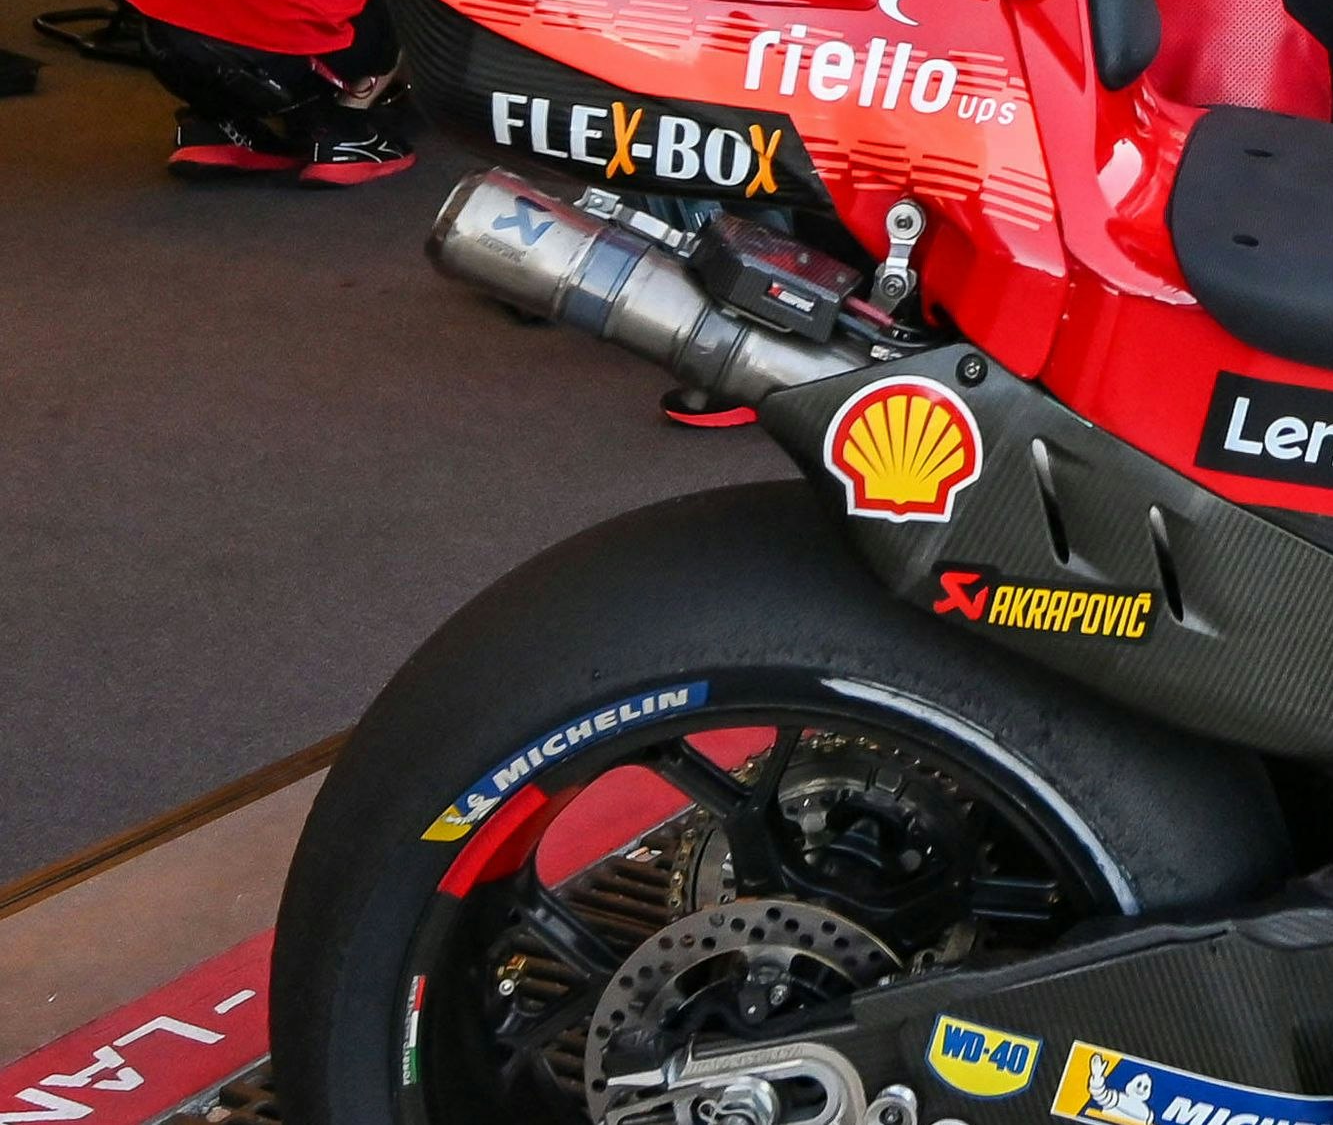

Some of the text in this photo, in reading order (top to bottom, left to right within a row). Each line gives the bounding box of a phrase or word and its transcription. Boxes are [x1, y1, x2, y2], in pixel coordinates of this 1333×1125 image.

[744, 23, 1018, 127] riello ups
[491, 91, 783, 198] FLEX-BOX
[988, 584, 1152, 639] AKRAPOVIČ
[492, 686, 689, 793] MICHELIN
[940, 1023, 1030, 1074] WD-40
